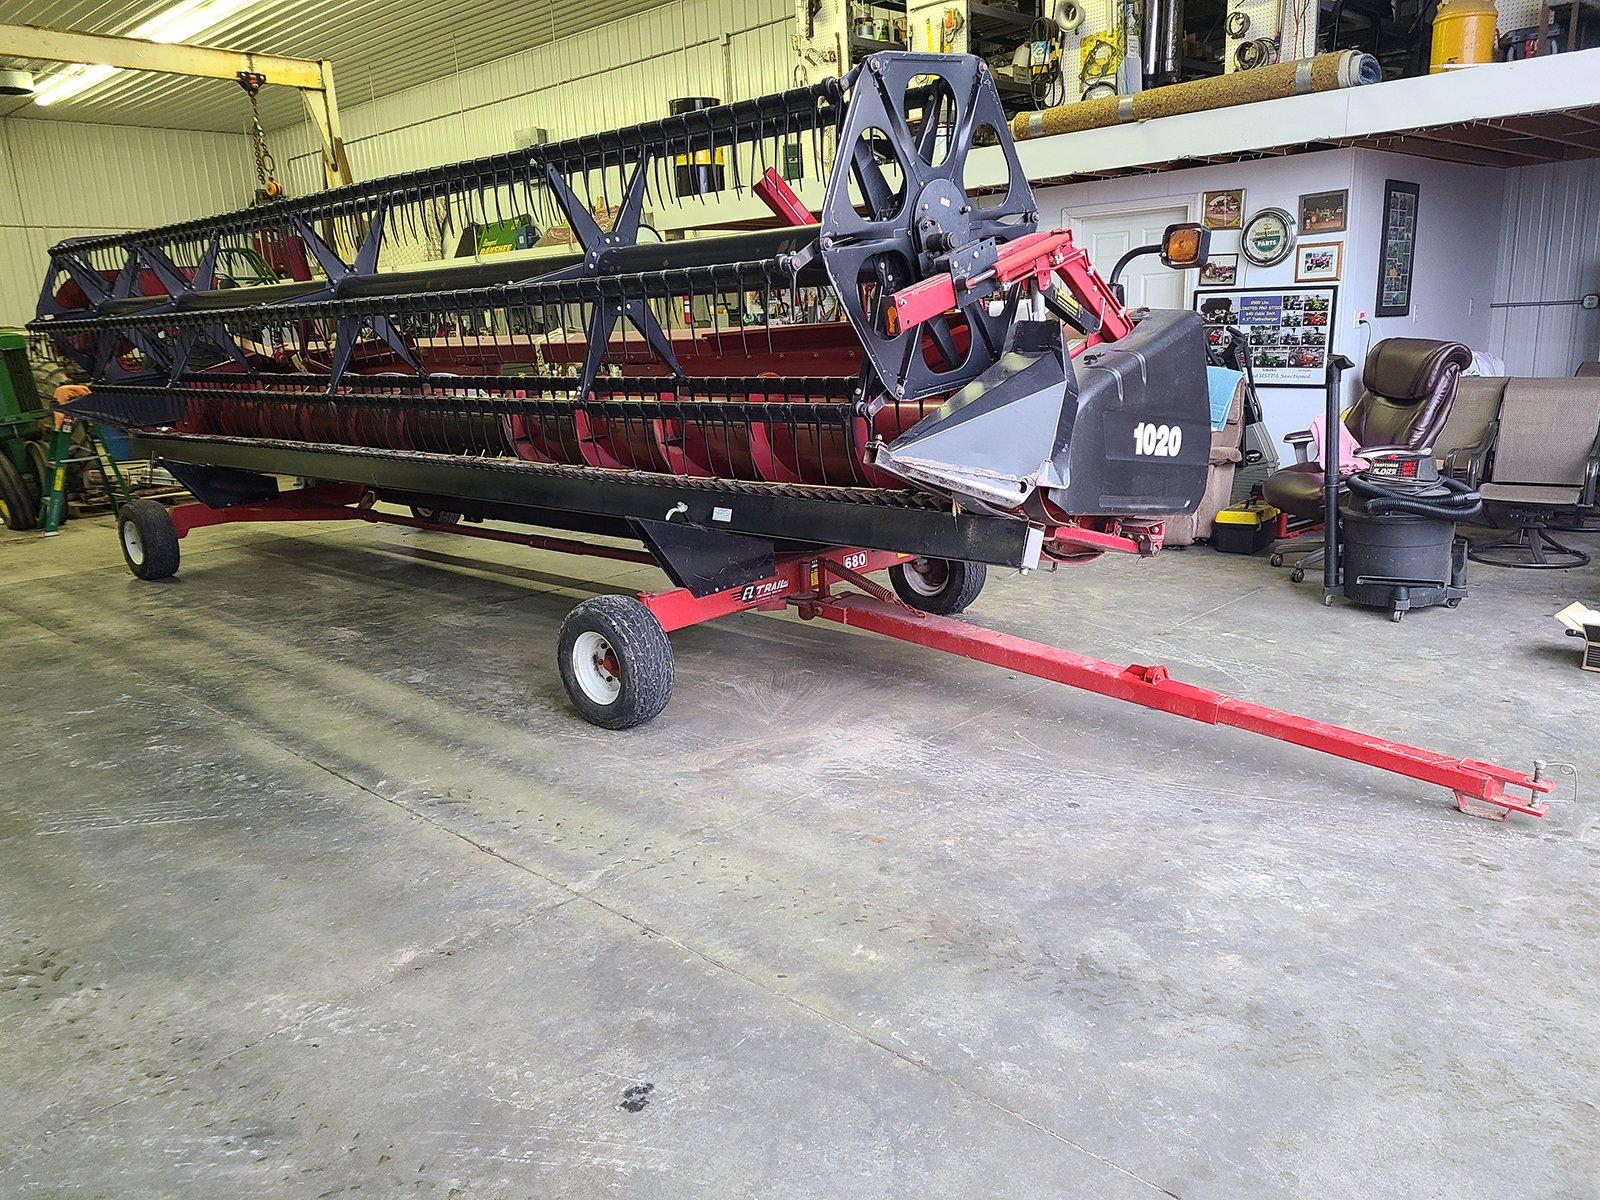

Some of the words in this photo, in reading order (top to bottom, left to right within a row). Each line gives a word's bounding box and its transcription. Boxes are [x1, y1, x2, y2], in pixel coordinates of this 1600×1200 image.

[1133, 422, 1182, 457] 1020
[845, 553, 866, 569] 680
[756, 579, 789, 595] TRAIL
